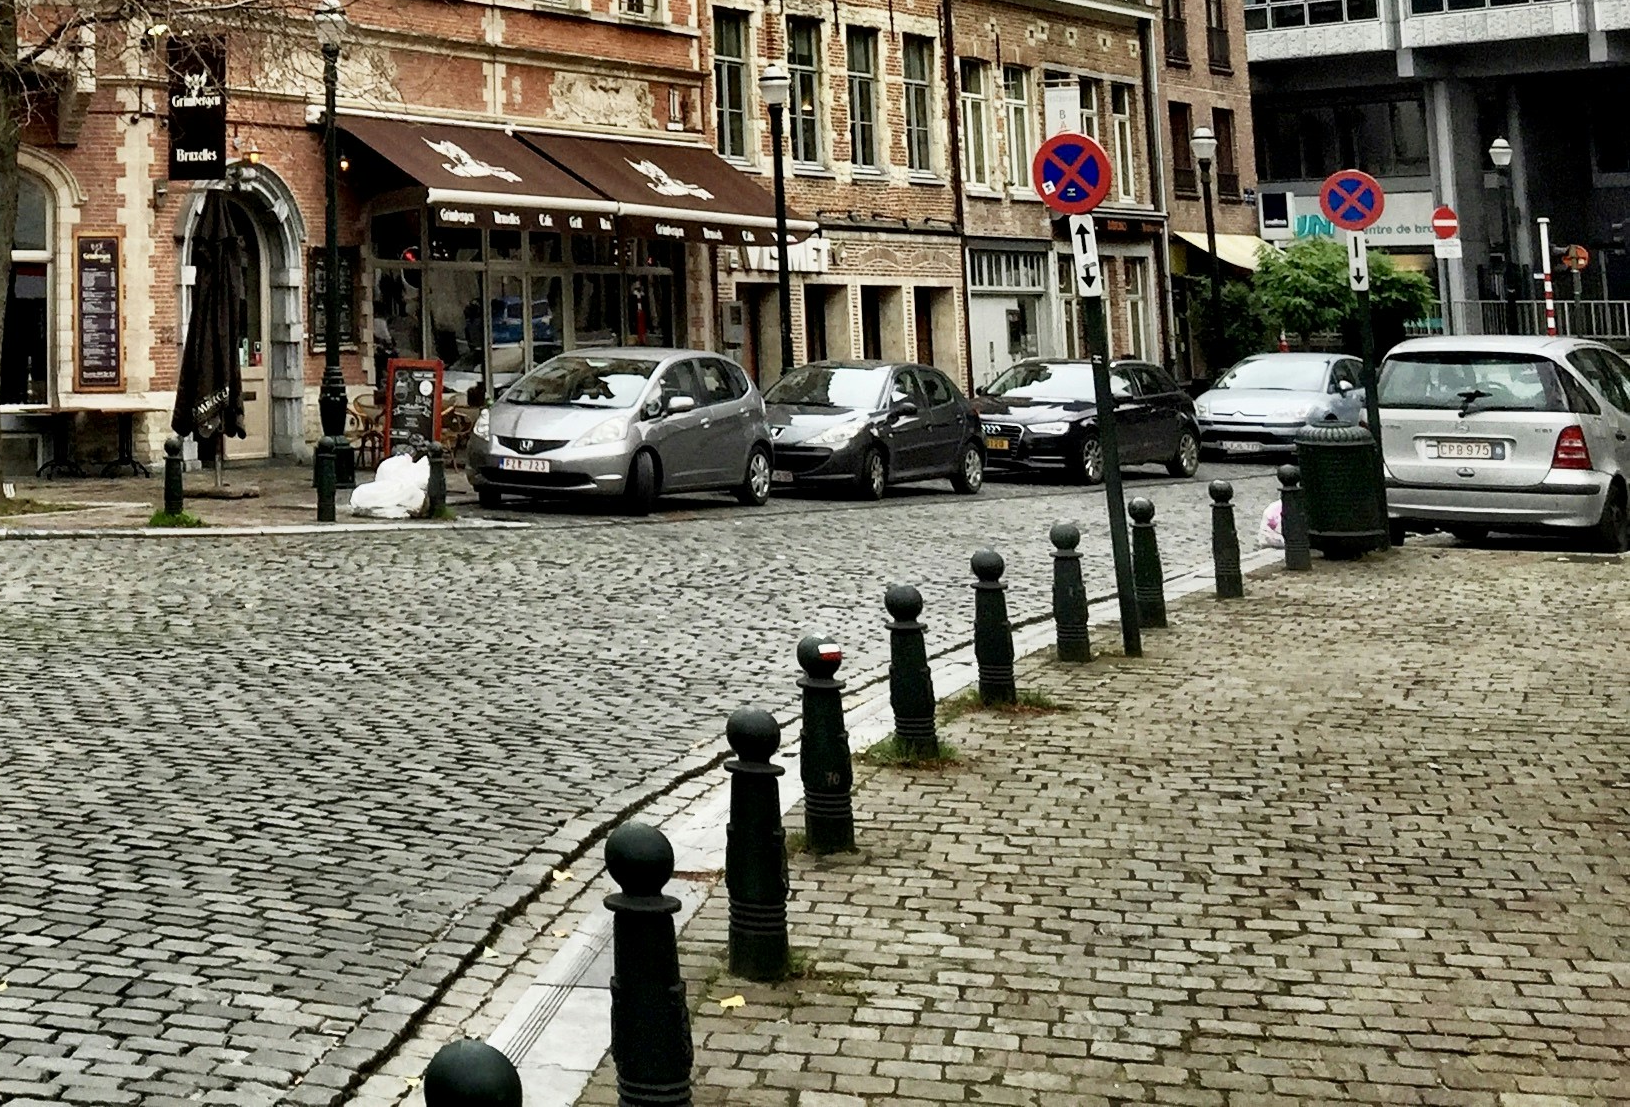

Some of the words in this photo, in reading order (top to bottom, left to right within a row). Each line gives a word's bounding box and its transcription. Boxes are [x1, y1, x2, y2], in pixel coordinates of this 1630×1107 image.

[172, 95, 221, 109] Grimbergen
[176, 148, 217, 162] Bruxelles
[1363, 224, 1392, 234] entre
[1396, 224, 1411, 234] de
[1415, 224, 1434, 234] bro
